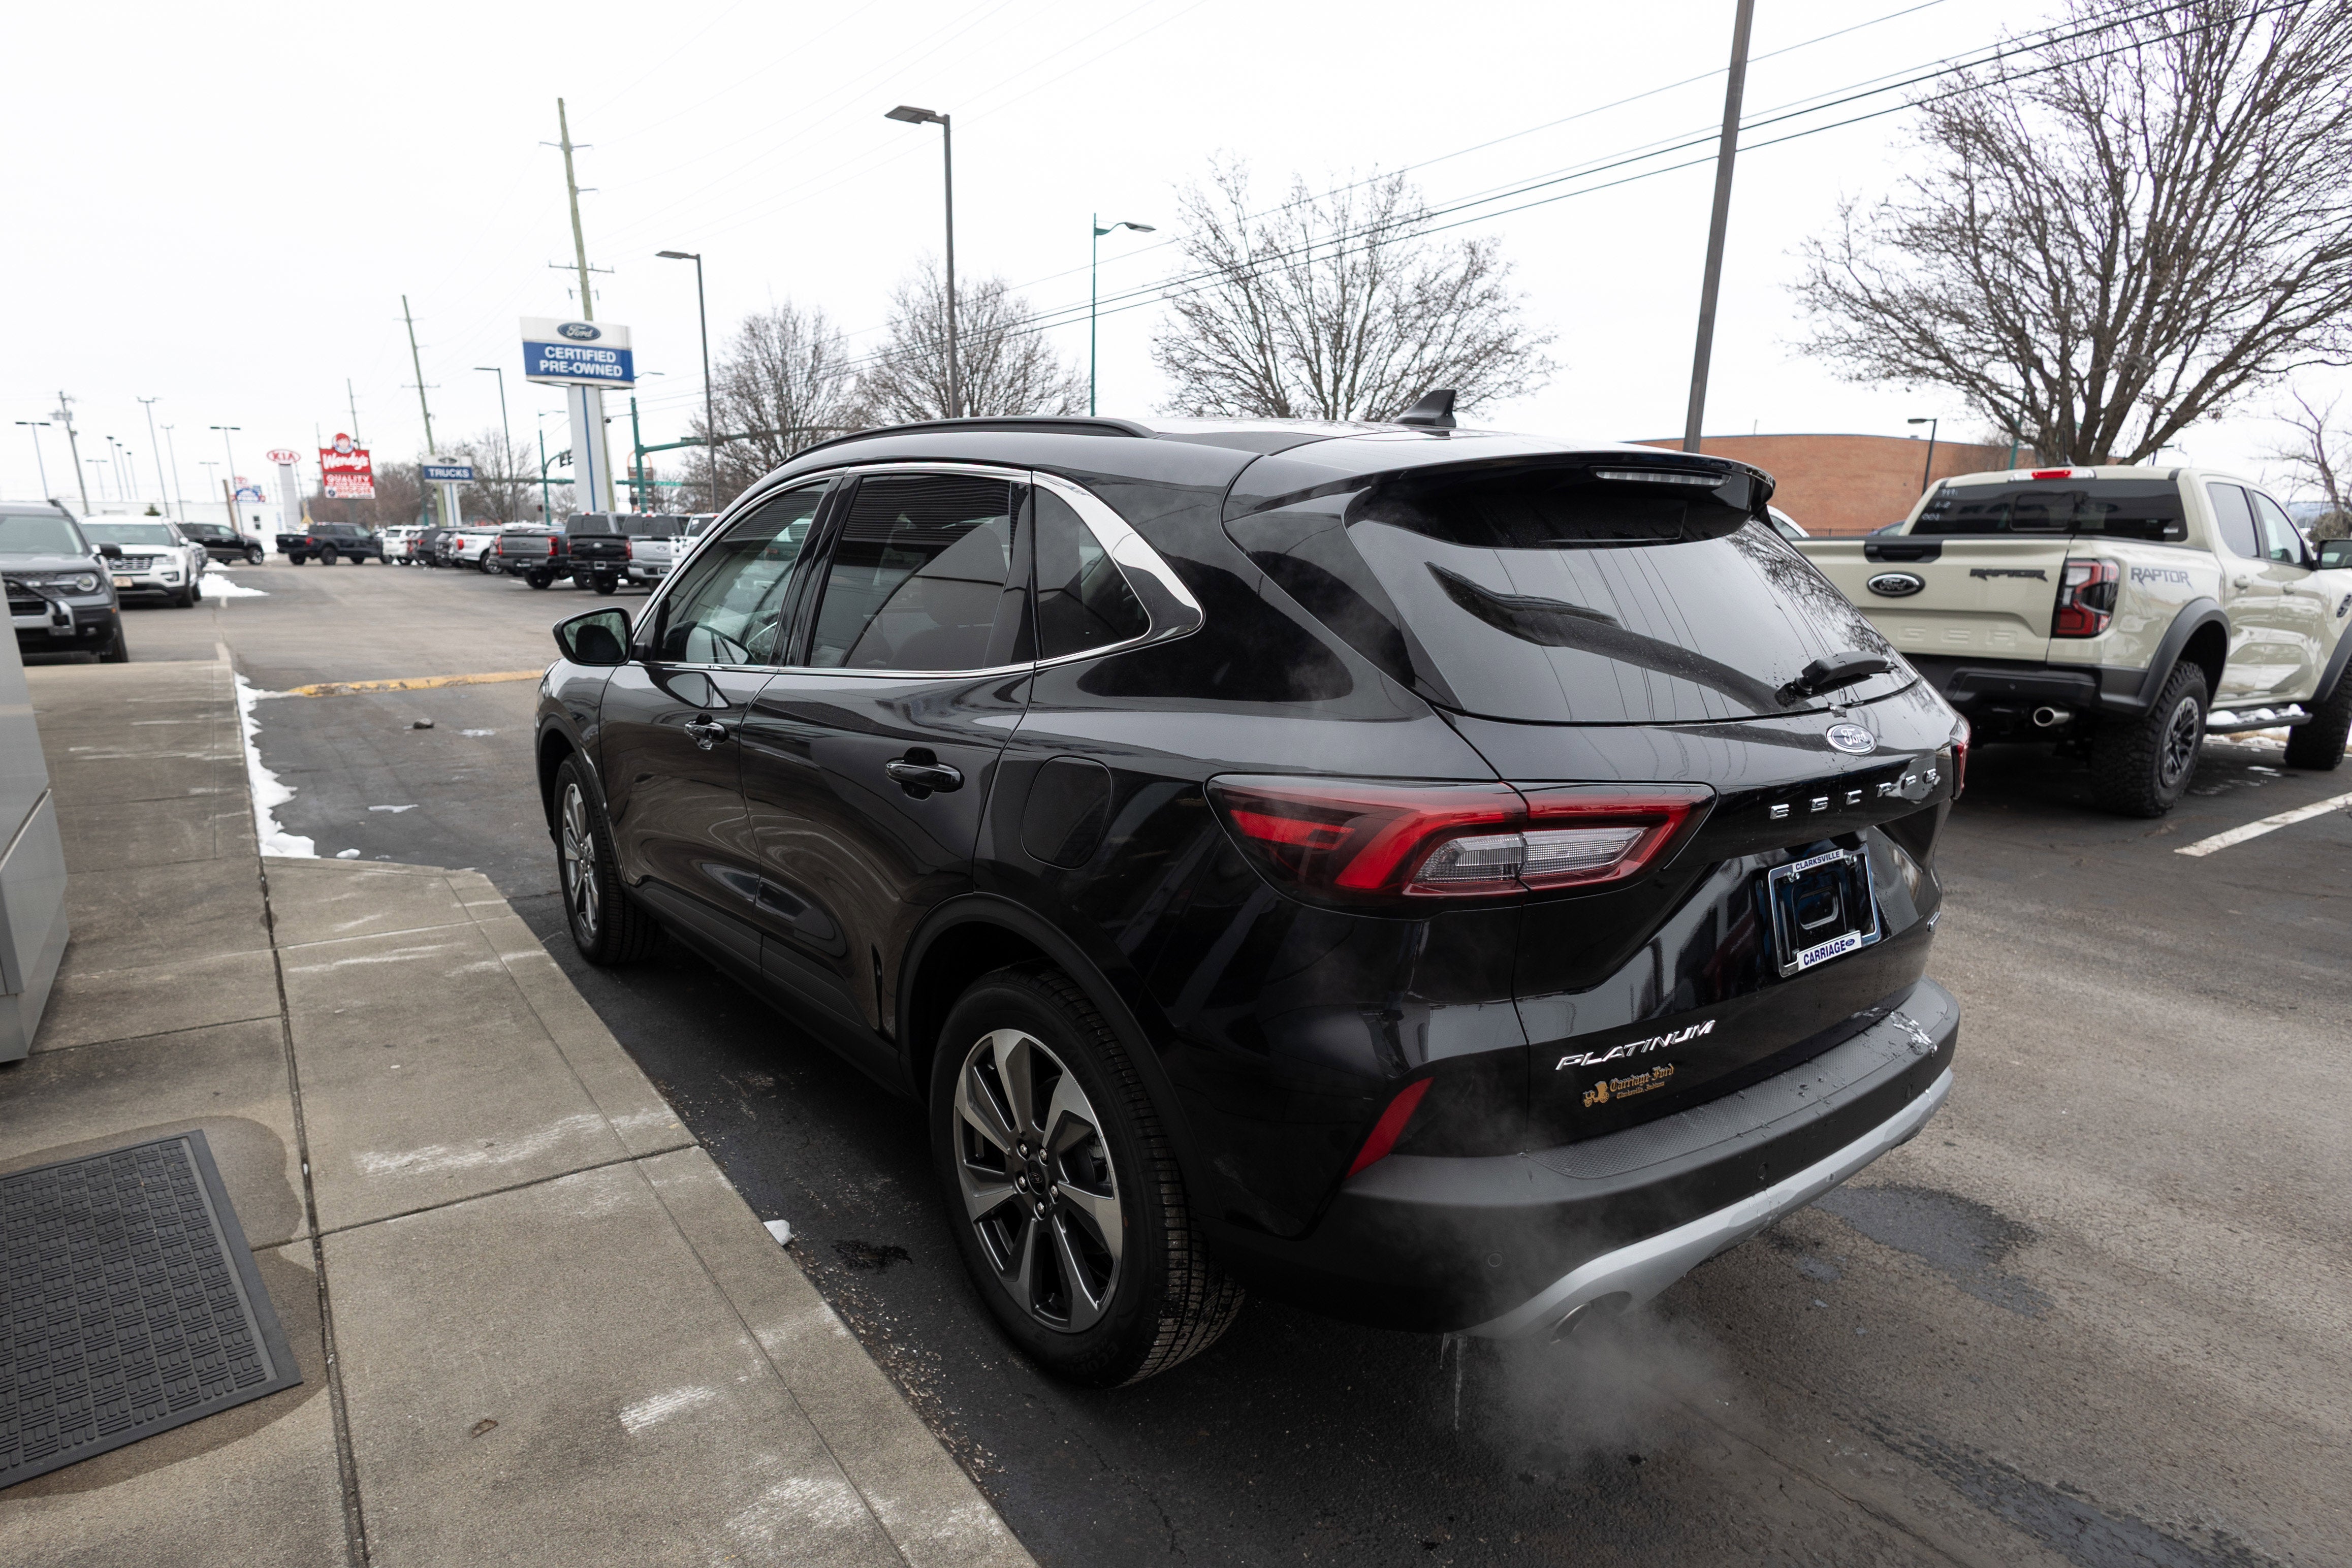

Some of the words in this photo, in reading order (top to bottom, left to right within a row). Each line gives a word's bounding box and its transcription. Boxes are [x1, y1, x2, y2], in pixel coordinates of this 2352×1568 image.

[566, 324, 593, 338] Ford
[545, 346, 616, 363] CERTIFIED
[539, 360, 623, 377] PRE-OWNED
[272, 452, 296, 461] KIA
[322, 451, 369, 470] Wendy's
[326, 474, 370, 483] QUALITY
[428, 468, 469, 478] TRUCKS
[1879, 578, 1908, 590] Ford
[1970, 568, 2049, 583] RAPTOR
[2131, 567, 2193, 589] RAPTOR
[1840, 728, 1869, 746] Ford
[1795, 851, 1840, 871] CLARKSVILLE
[1803, 940, 1847, 966] CARRIAGE
[1555, 1019, 1716, 1070] PLATINUM
[1609, 1072, 1651, 1092] Carriage
[1651, 1063, 1674, 1081] Ford
